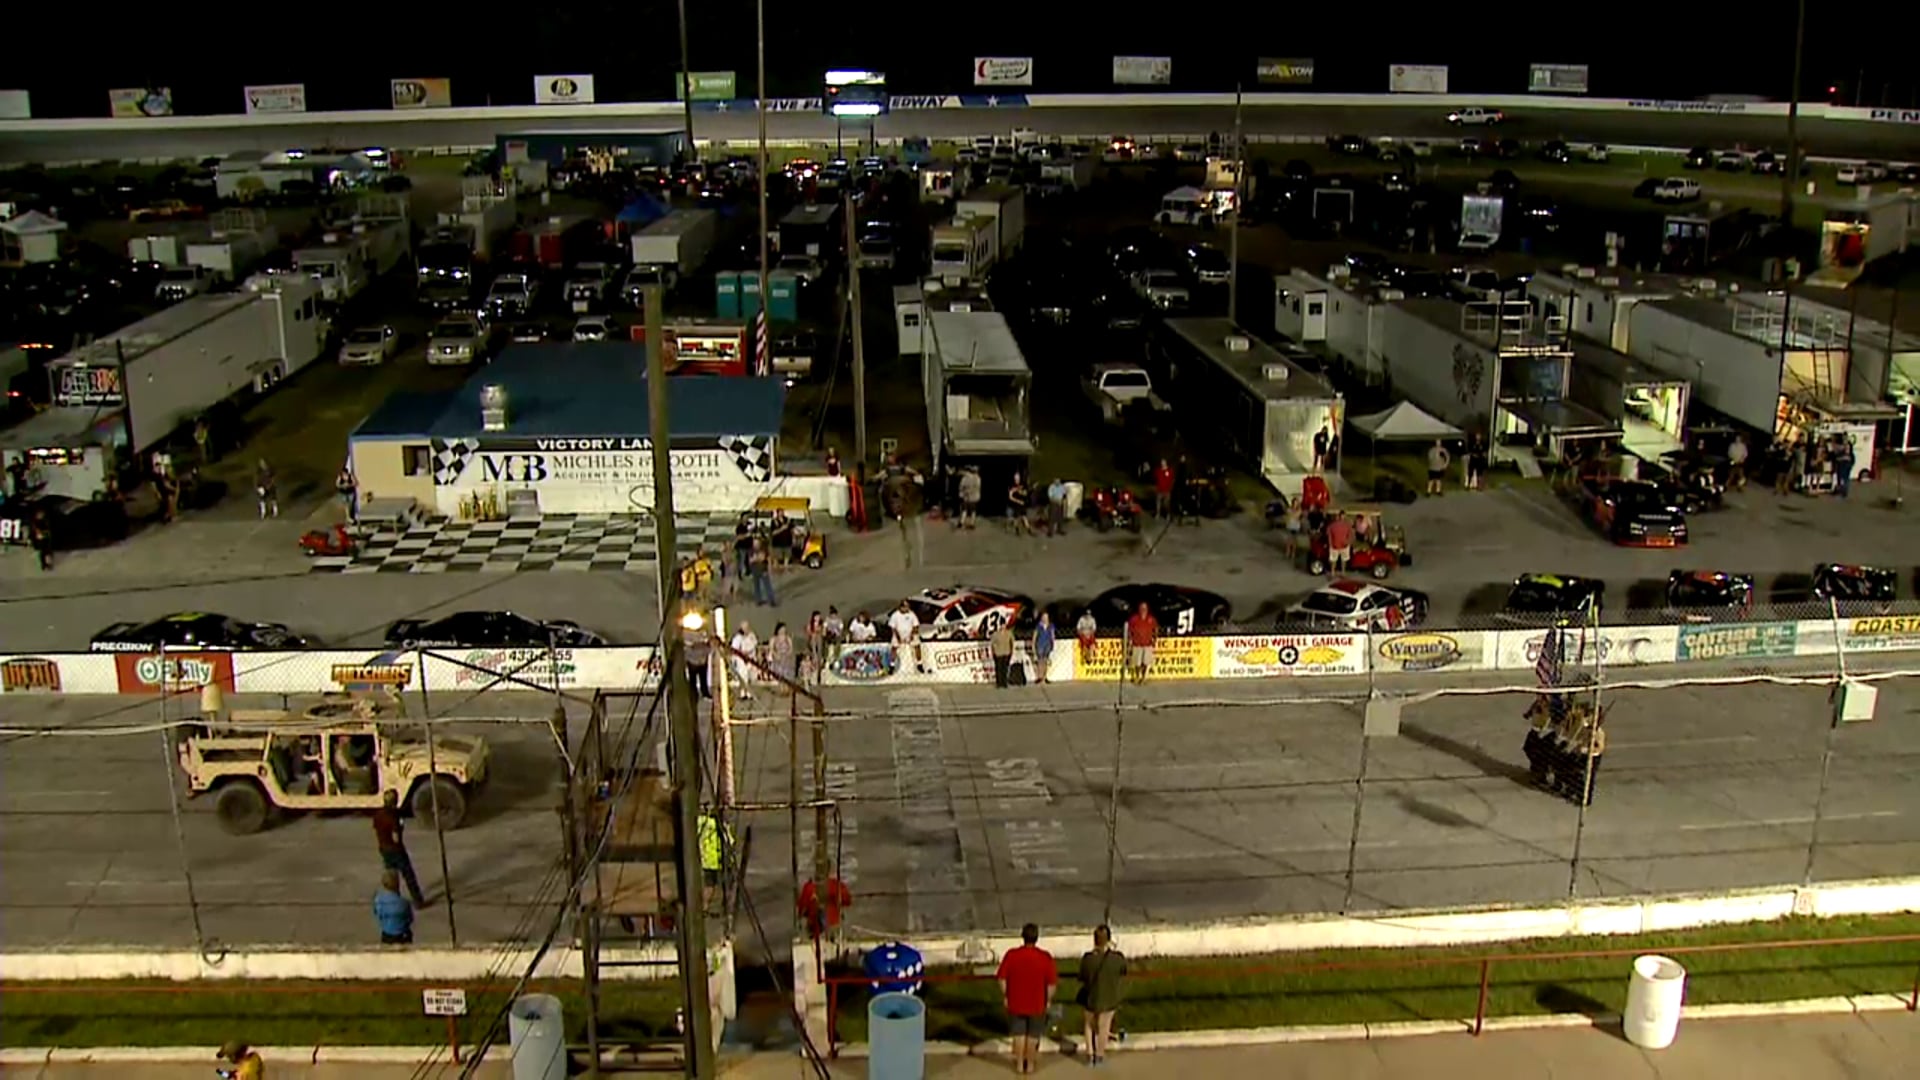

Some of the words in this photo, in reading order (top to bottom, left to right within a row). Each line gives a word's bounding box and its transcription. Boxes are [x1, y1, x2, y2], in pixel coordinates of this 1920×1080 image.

[537, 438, 615, 450] VICTORY
[620, 438, 654, 450] LAN
[553, 455, 634, 469] MICHLES
[669, 454, 720, 469] OOTH
[553, 472, 608, 480] ACCIDENT
[0, 519, 21, 538] 81
[1177, 607, 1195, 634] 51
[1223, 639, 1269, 649] WINGED
[1271, 637, 1308, 647] WHEEL
[1311, 636, 1354, 647] GARAGE
[1688, 641, 1748, 660] HOUSE
[138, 657, 211, 684] O'Rilly
